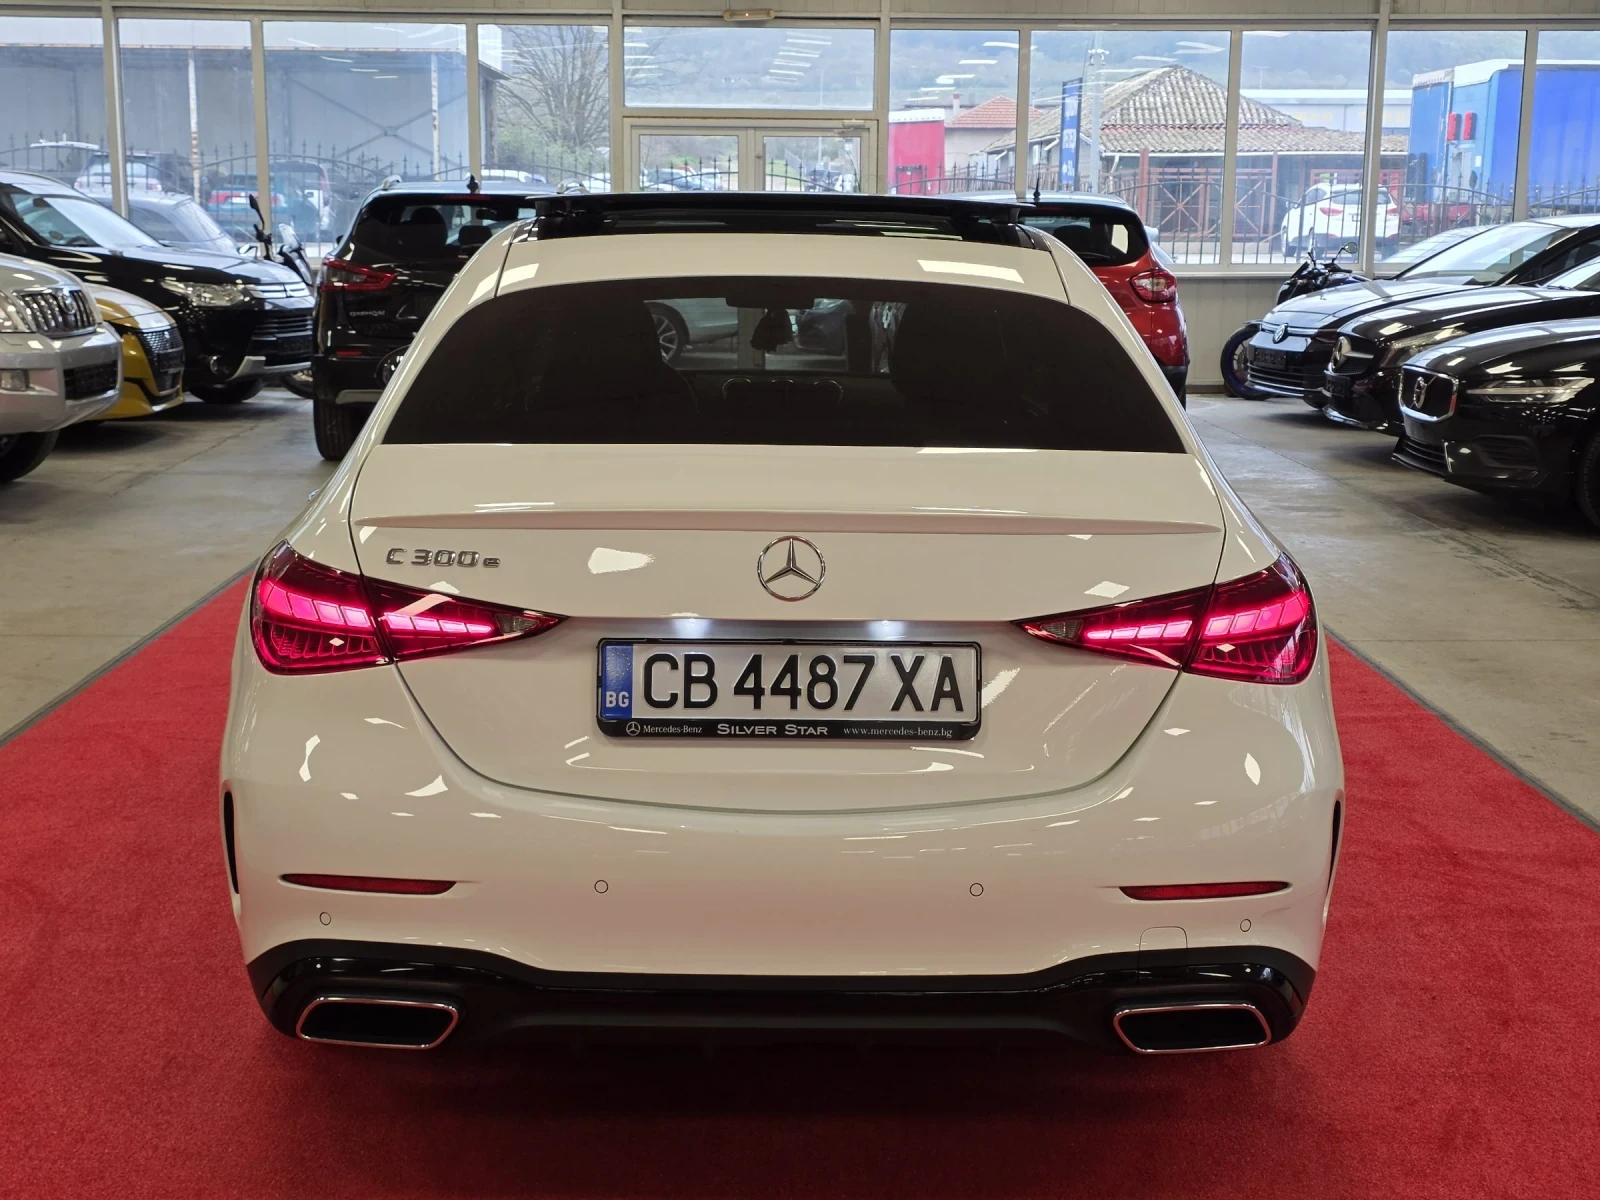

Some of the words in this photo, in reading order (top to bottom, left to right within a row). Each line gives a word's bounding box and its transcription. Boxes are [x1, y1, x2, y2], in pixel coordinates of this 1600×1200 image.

[386, 548, 407, 565] C
[643, 653, 718, 709] CB
[733, 655, 875, 711] 4487
[890, 656, 963, 712] XA
[606, 692, 629, 708] BG
[643, 725, 702, 734] Mercedes-Benz
[843, 727, 953, 738] www.mercedes-benz.bg
